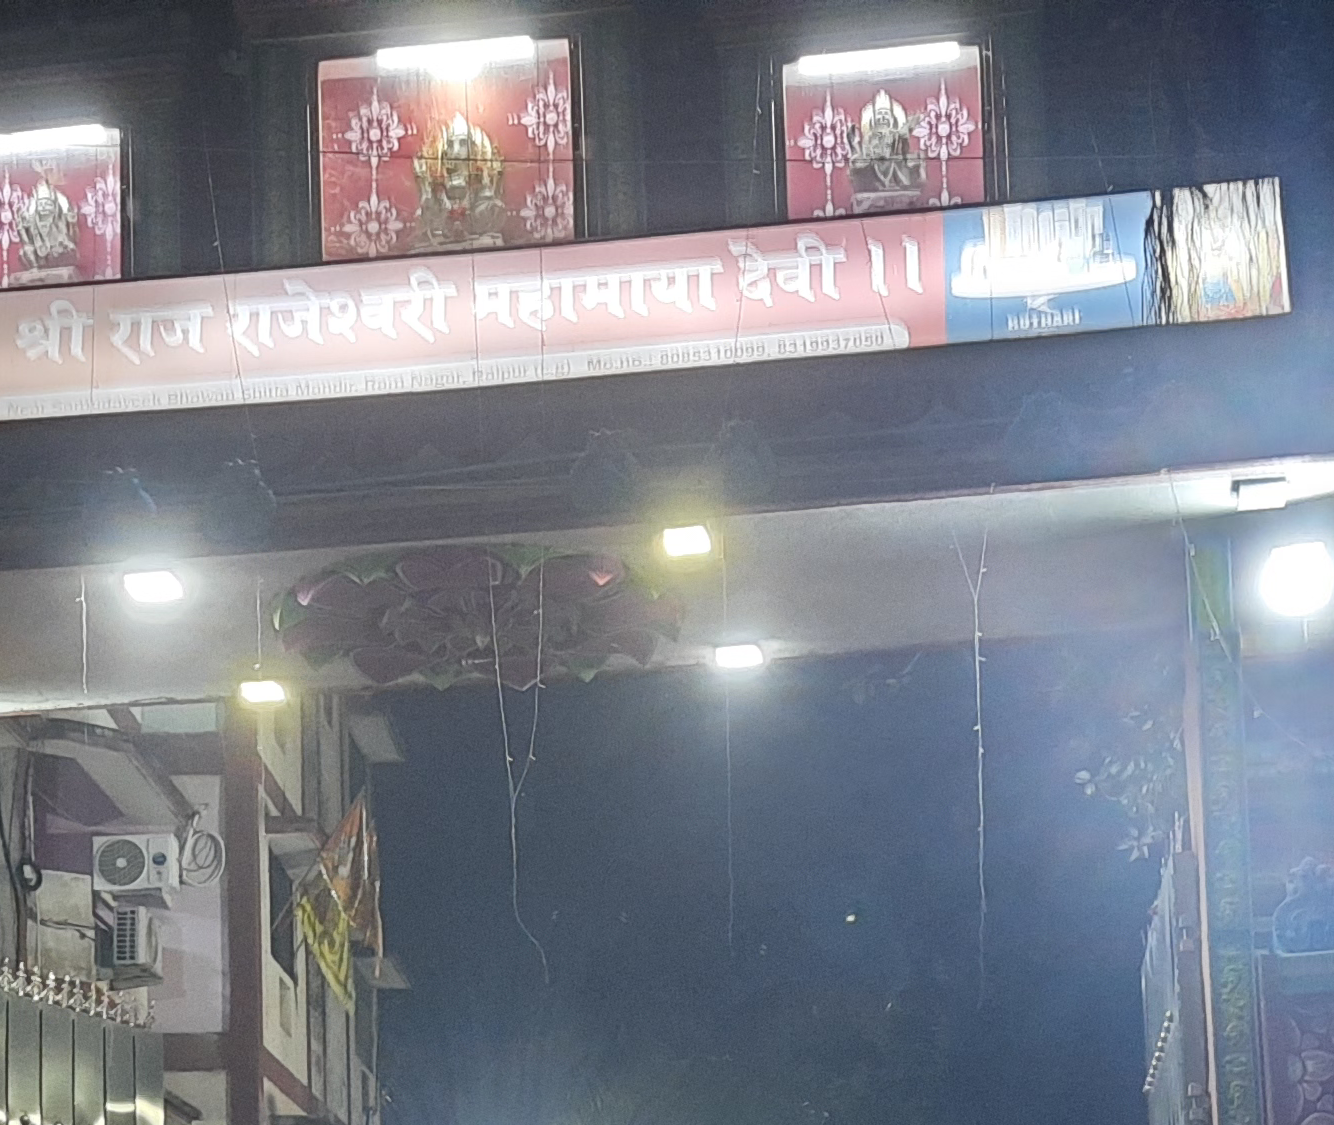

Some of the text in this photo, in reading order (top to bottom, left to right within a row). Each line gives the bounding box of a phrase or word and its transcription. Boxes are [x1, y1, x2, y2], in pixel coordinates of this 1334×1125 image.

[16, 299, 93, 365] श्री
[108, 302, 214, 366] राज
[228, 266, 459, 357] राजेश्वरी
[473, 256, 724, 332] महामाया
[728, 231, 848, 307] देवी
